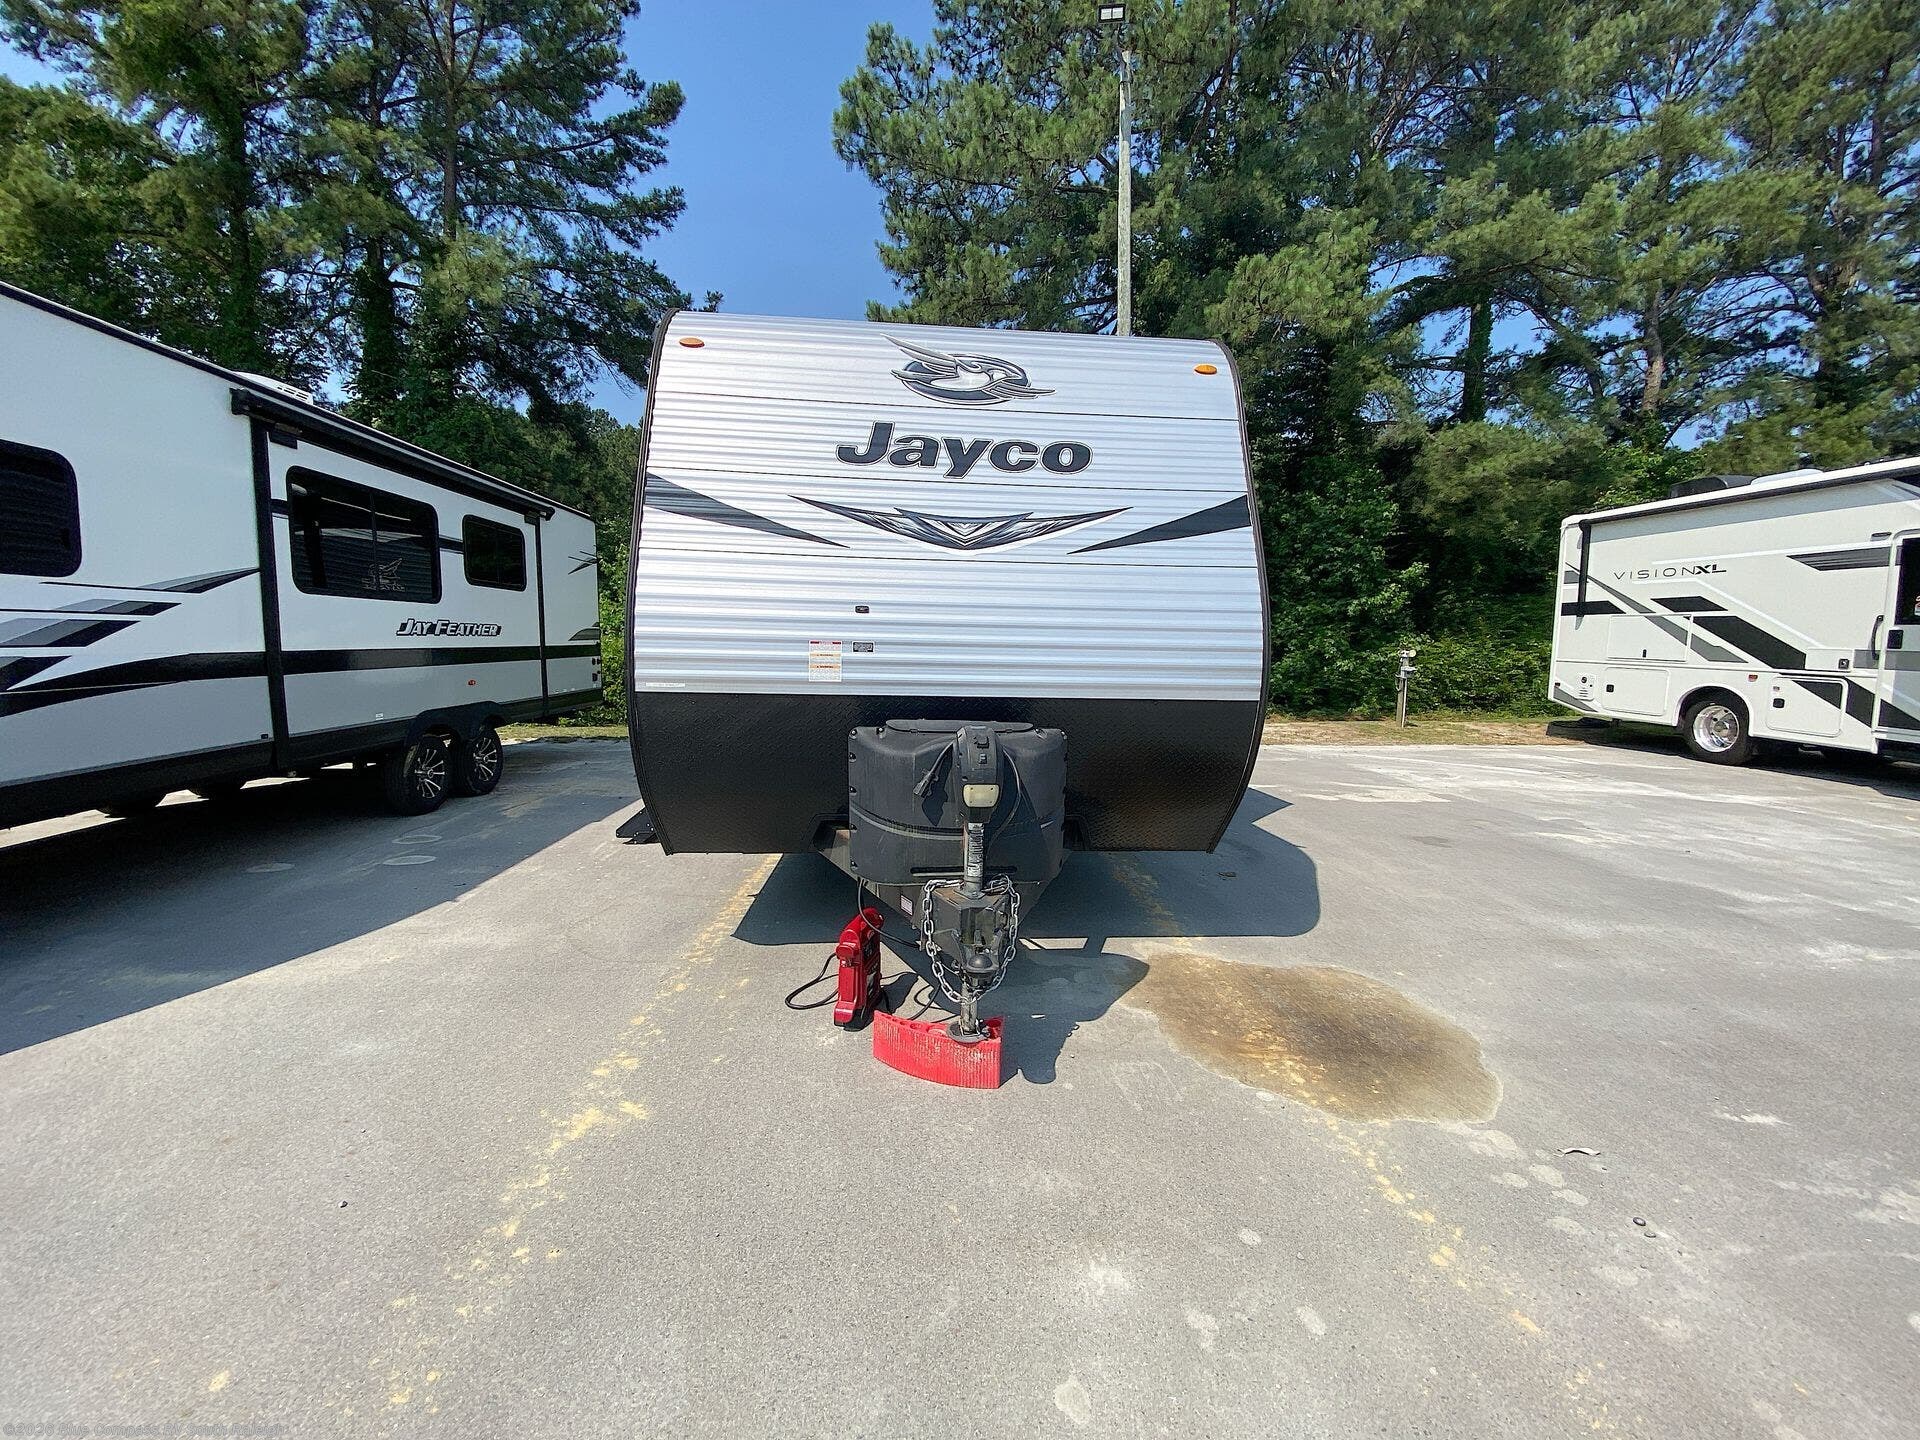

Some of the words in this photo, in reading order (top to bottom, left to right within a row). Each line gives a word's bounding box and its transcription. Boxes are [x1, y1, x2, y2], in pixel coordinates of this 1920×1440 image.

[837, 421, 1092, 478] Jayco
[396, 618, 432, 636] JAY
[434, 619, 500, 636] FEATHER
